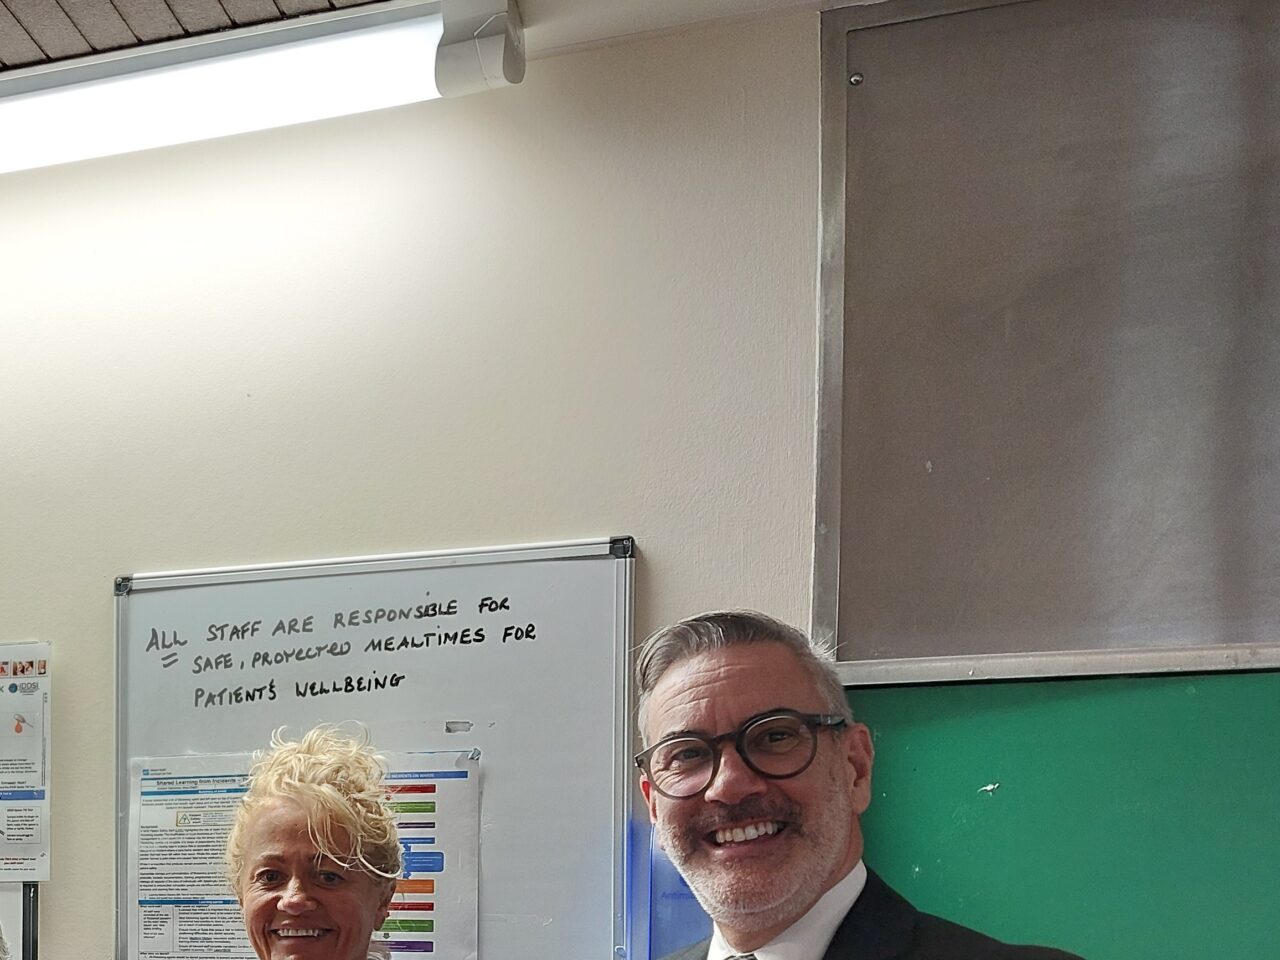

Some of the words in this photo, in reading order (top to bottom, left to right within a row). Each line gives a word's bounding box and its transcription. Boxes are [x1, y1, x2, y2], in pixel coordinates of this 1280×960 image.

[145, 627, 188, 652] ALL
[206, 620, 262, 642] STAFF
[272, 615, 314, 636] ARE
[478, 596, 510, 614] FOR
[502, 623, 536, 643] FOR
